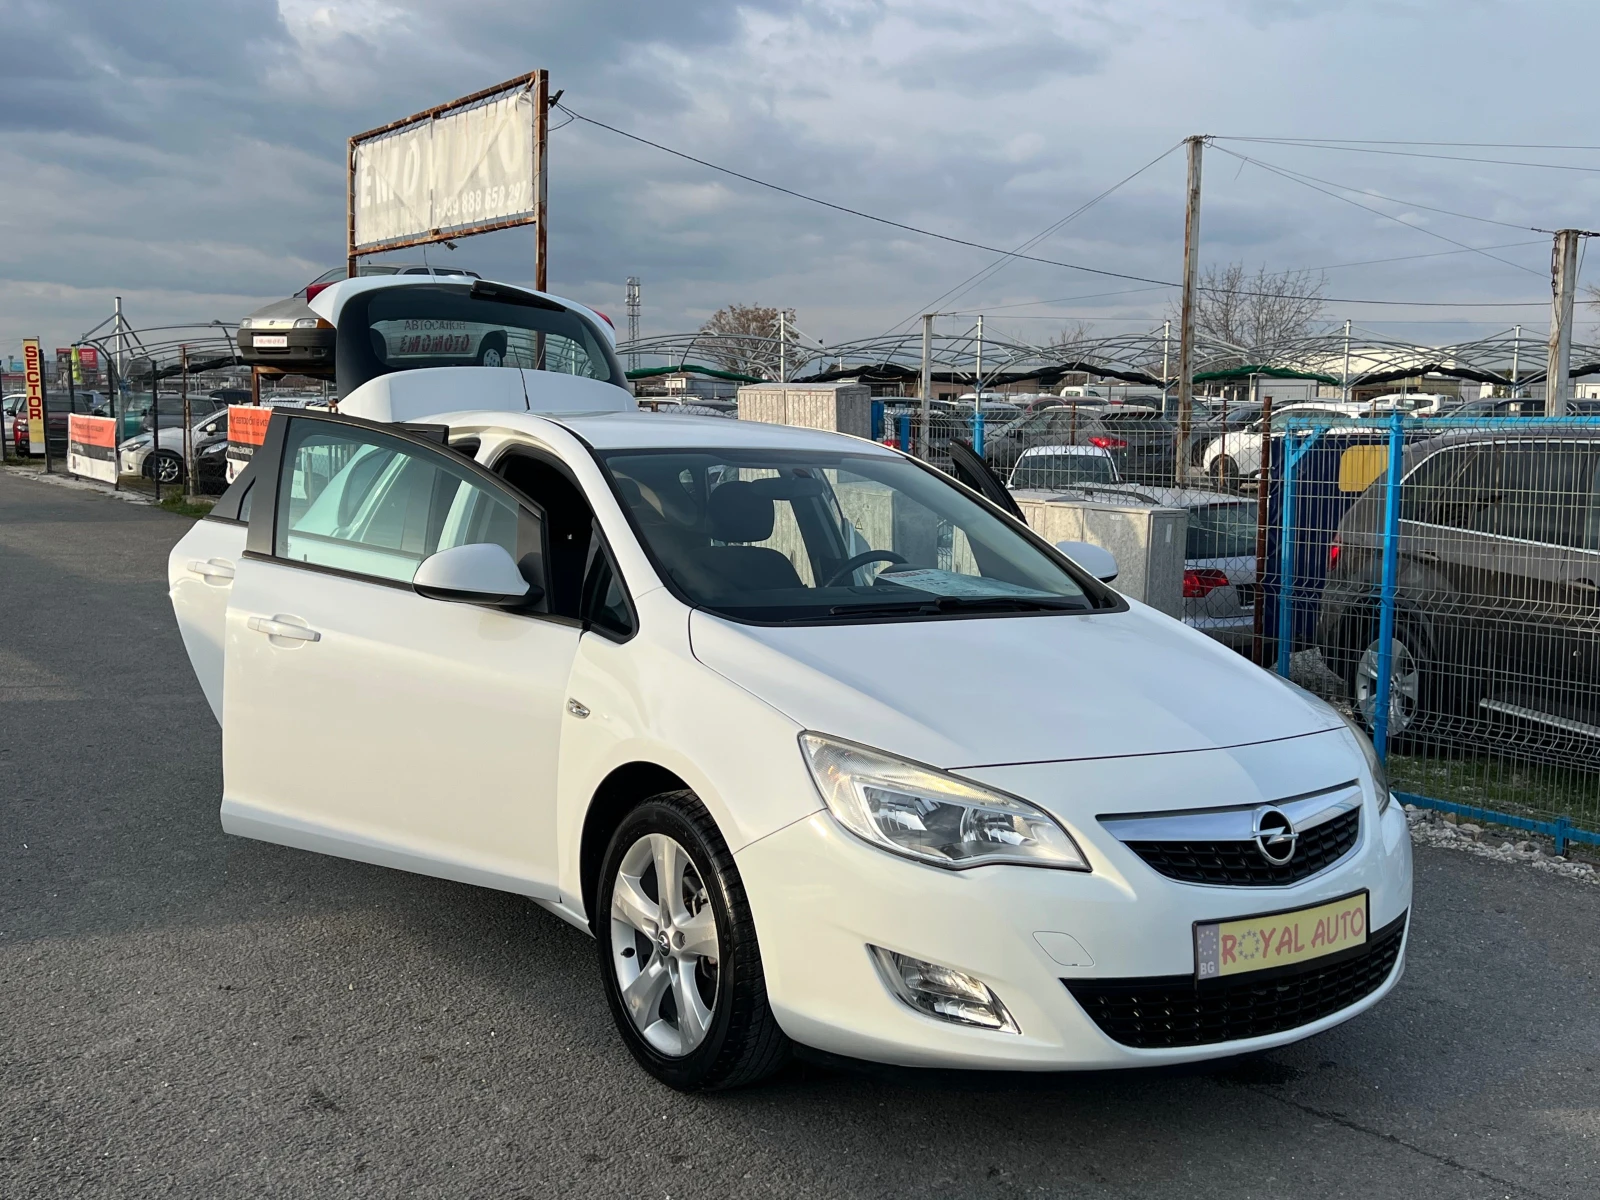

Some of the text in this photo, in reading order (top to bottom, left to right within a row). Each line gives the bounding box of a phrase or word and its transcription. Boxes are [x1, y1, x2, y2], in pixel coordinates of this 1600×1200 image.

[461, 190, 482, 213] 888
[484, 185, 506, 210] 658
[507, 180, 527, 205] 297
[25, 345, 42, 420] SECTOR
[1221, 907, 1364, 966] ROYAL AUTO
[1200, 961, 1215, 976] BG
